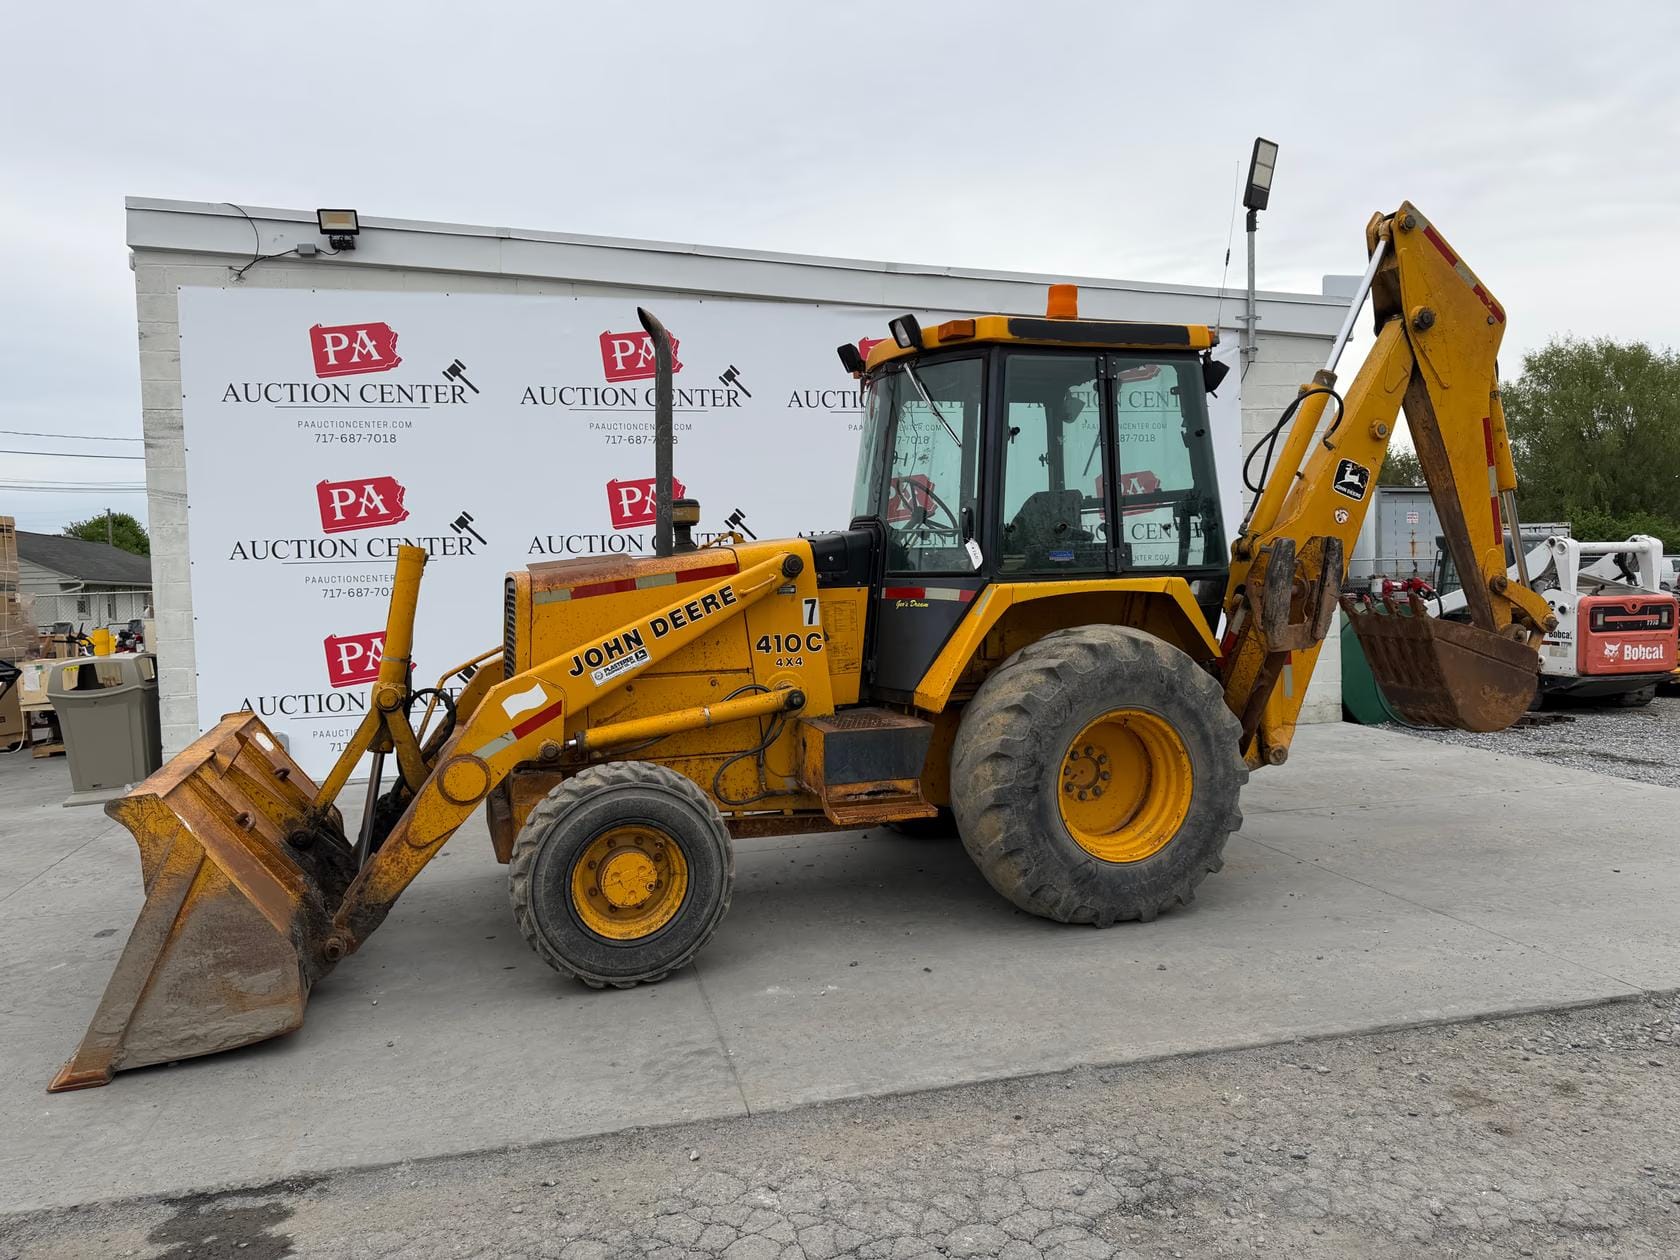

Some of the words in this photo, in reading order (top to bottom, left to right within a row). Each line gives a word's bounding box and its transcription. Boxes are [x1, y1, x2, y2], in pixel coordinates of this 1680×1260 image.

[322, 330, 383, 366] PA
[221, 383, 351, 404] AUCTION
[359, 384, 469, 405] CENTER
[520, 386, 637, 407] AUCTION
[787, 389, 866, 409] AUCTI
[297, 420, 413, 430] PAAUCTIONCENTER.COM
[589, 422, 692, 431] PAAUCTIONCENCOM
[314, 433, 397, 444] 717-687-7018
[605, 435, 679, 446] 717-687-78
[329, 484, 391, 521] PA
[229, 538, 358, 561] AUCTION
[528, 533, 643, 555] AUCTION
[305, 574, 395, 584] PAAUCTIONCENTER
[322, 587, 394, 599] 717-687-70
[804, 599, 817, 625] 7
[569, 628, 644, 677] JOHN
[649, 585, 737, 639] DEERE
[775, 657, 803, 667] 4X4
[1623, 644, 1664, 661] Bobcat
[240, 691, 365, 716] AUCTION
